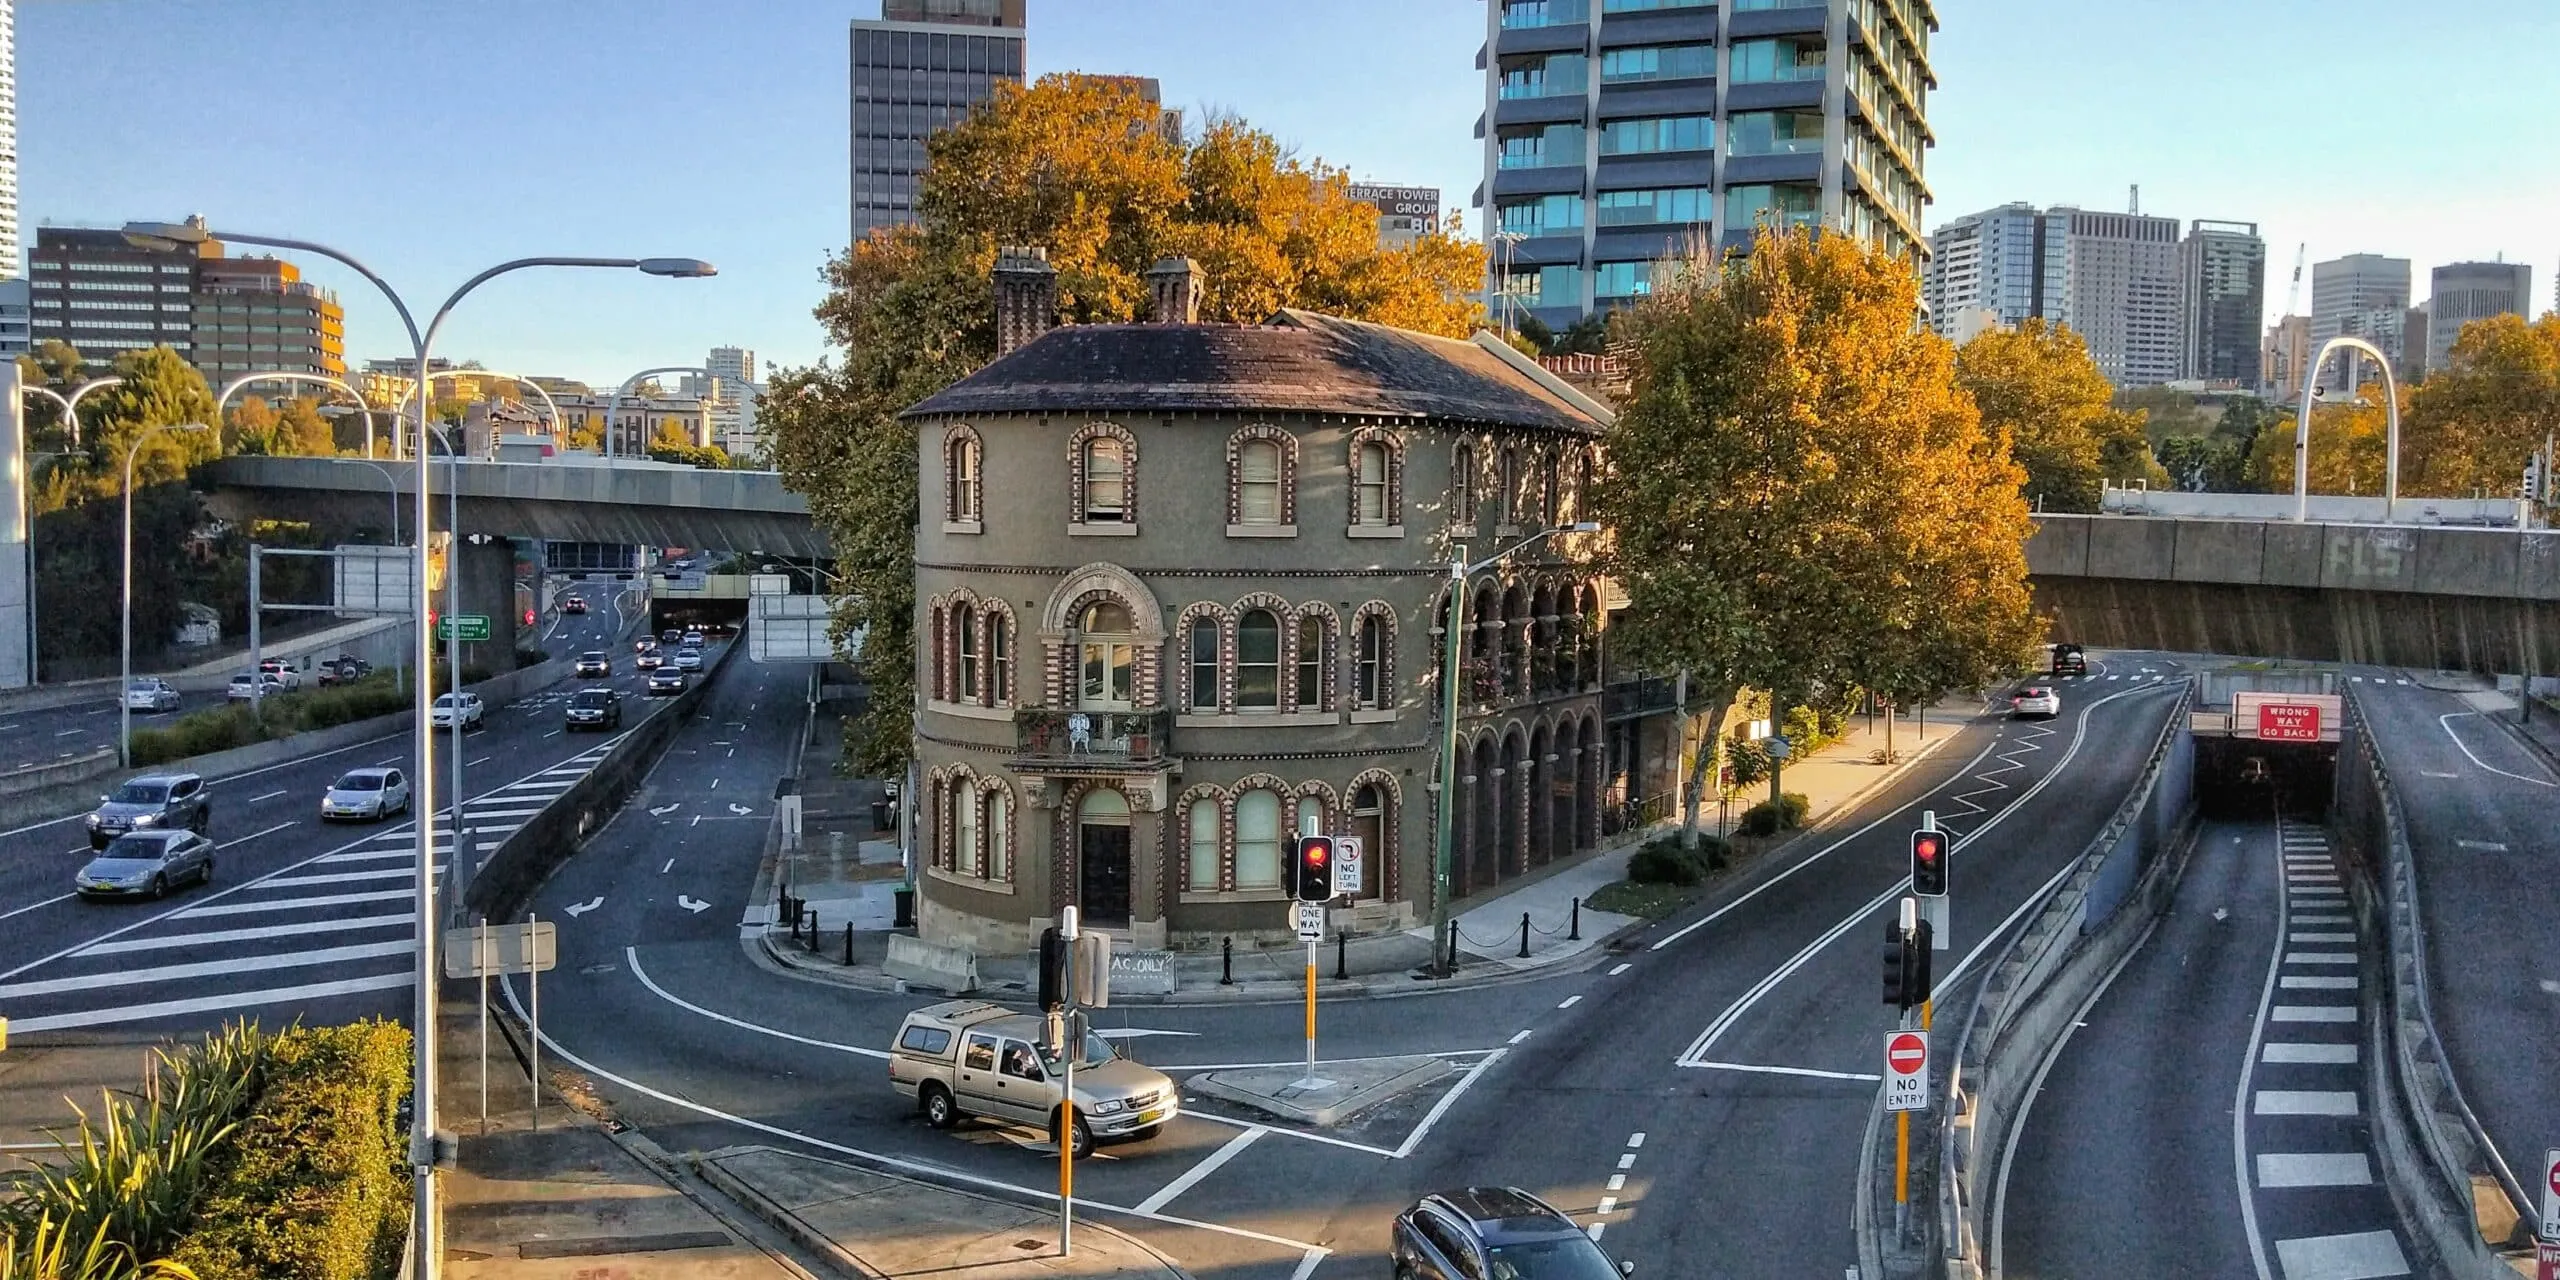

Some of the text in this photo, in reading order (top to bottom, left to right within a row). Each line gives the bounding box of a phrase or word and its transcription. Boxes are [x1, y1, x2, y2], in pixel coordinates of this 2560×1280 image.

[1344, 187, 1438, 201] TERRACE TOWER
[1395, 203, 1437, 214] GROUP
[2269, 707, 2310, 716] WRONG
[2276, 717, 2302, 726] WAY
[2284, 729, 2315, 737] BACK
[1340, 864, 1355, 873] NO
[1338, 873, 1357, 881] LEFT
[1338, 881, 1358, 889] TURN
[1301, 909, 1320, 918] ONE
[1300, 920, 1321, 929] WAY
[1896, 1078, 1917, 1091] NO
[1889, 1094, 1925, 1105] ENTRY
